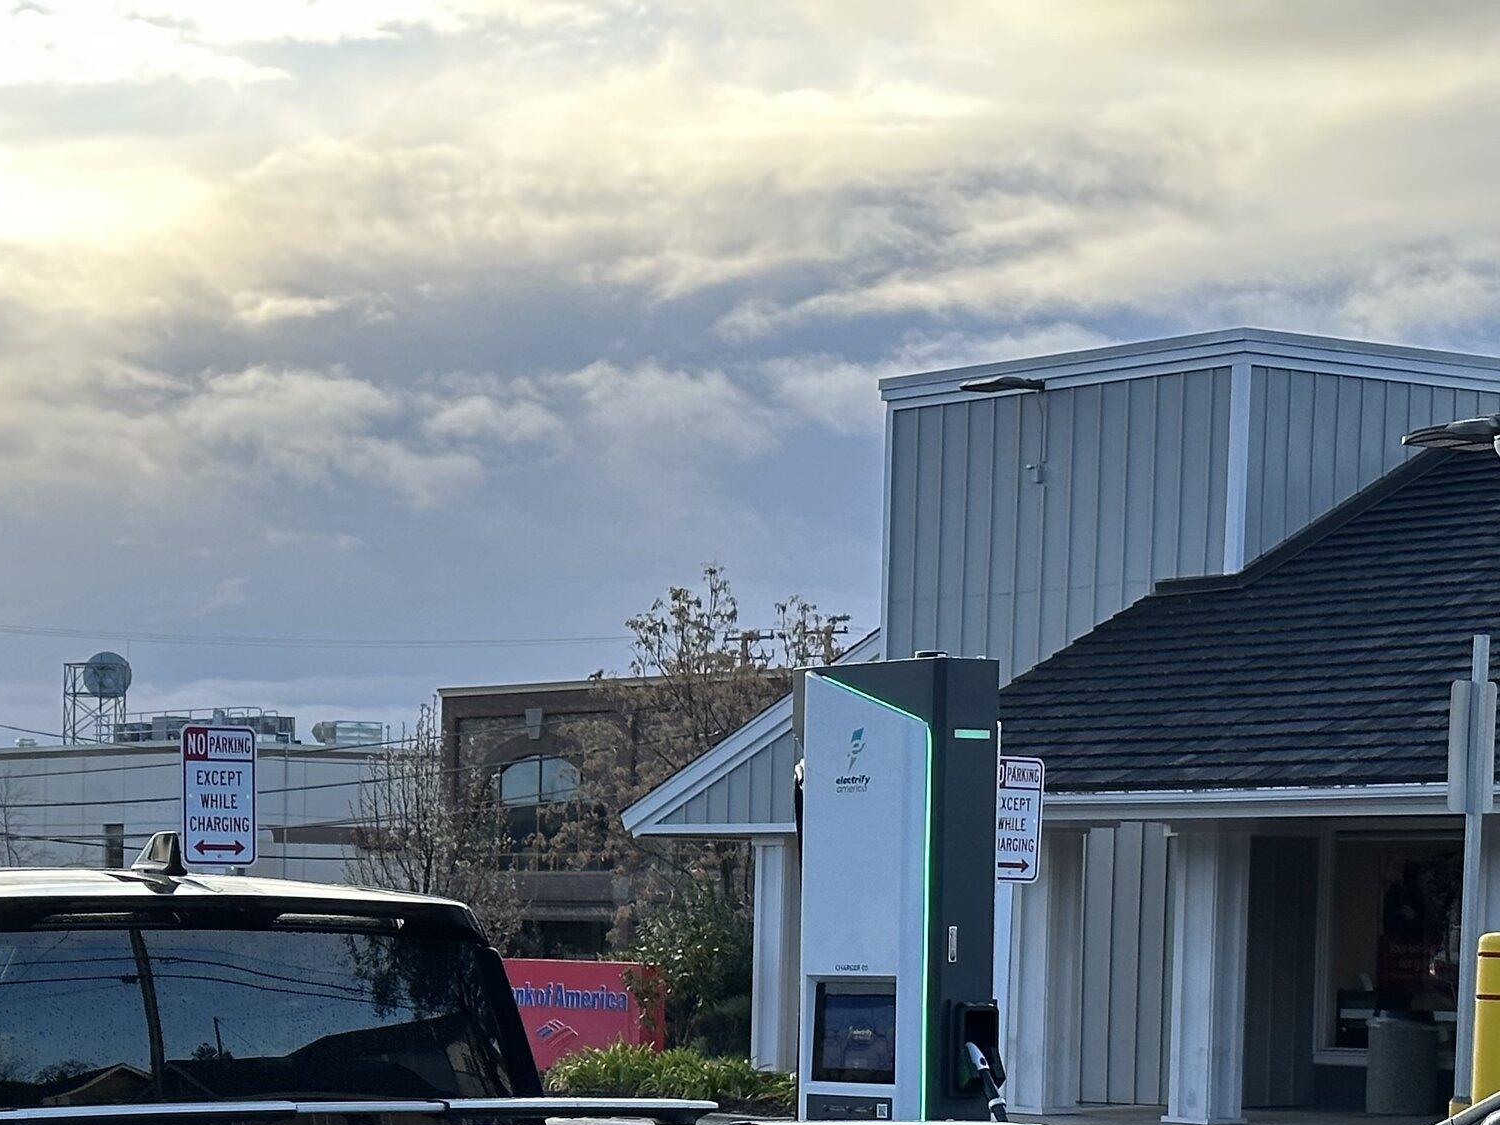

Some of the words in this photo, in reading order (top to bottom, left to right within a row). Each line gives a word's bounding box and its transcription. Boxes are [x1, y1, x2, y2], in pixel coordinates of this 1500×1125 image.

[187, 732, 206, 756] NO
[209, 736, 251, 754] PARKING
[196, 770, 243, 787] EXCEPT
[835, 774, 871, 786] electrify
[1007, 766, 1040, 783] PARKING
[200, 793, 238, 810] WHILE
[1000, 796, 1031, 812] XCEPT
[189, 816, 250, 833] CHARGING
[998, 817, 1027, 832] WHILE
[997, 838, 1035, 853] ARGING
[511, 981, 536, 1007] nk
[537, 981, 554, 1007] of
[555, 982, 629, 1011] America
